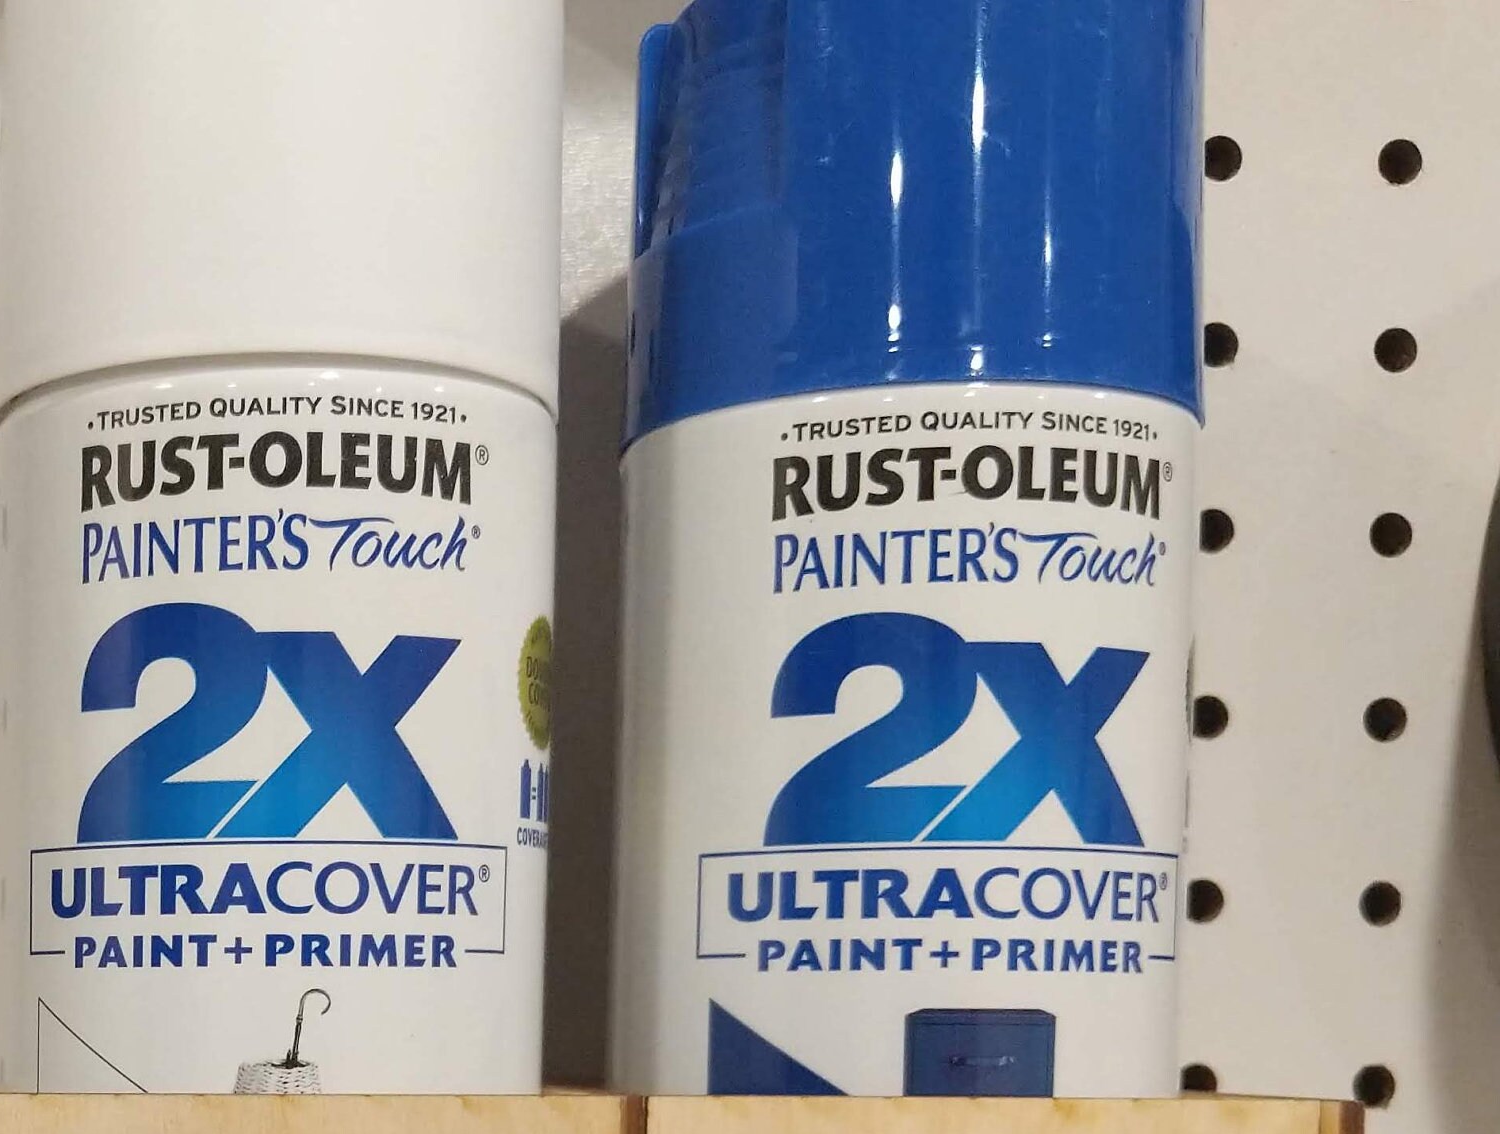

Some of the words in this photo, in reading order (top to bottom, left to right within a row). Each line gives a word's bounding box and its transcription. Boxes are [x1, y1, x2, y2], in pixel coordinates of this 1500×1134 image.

[97, 401, 202, 431] TRUSTED
[209, 397, 322, 417] QUALITY
[330, 395, 404, 418] SINCE
[411, 402, 456, 424] 1921
[793, 414, 912, 442] TRUSTED
[920, 411, 1034, 431] QUALITY
[1041, 411, 1107, 434] SINCE
[1112, 418, 1150, 440] 1921
[81, 508, 309, 584] PAINTER'S
[773, 522, 1019, 595] PAINTER'S
[76, 602, 462, 844] 2X
[763, 611, 1150, 847] 2X
